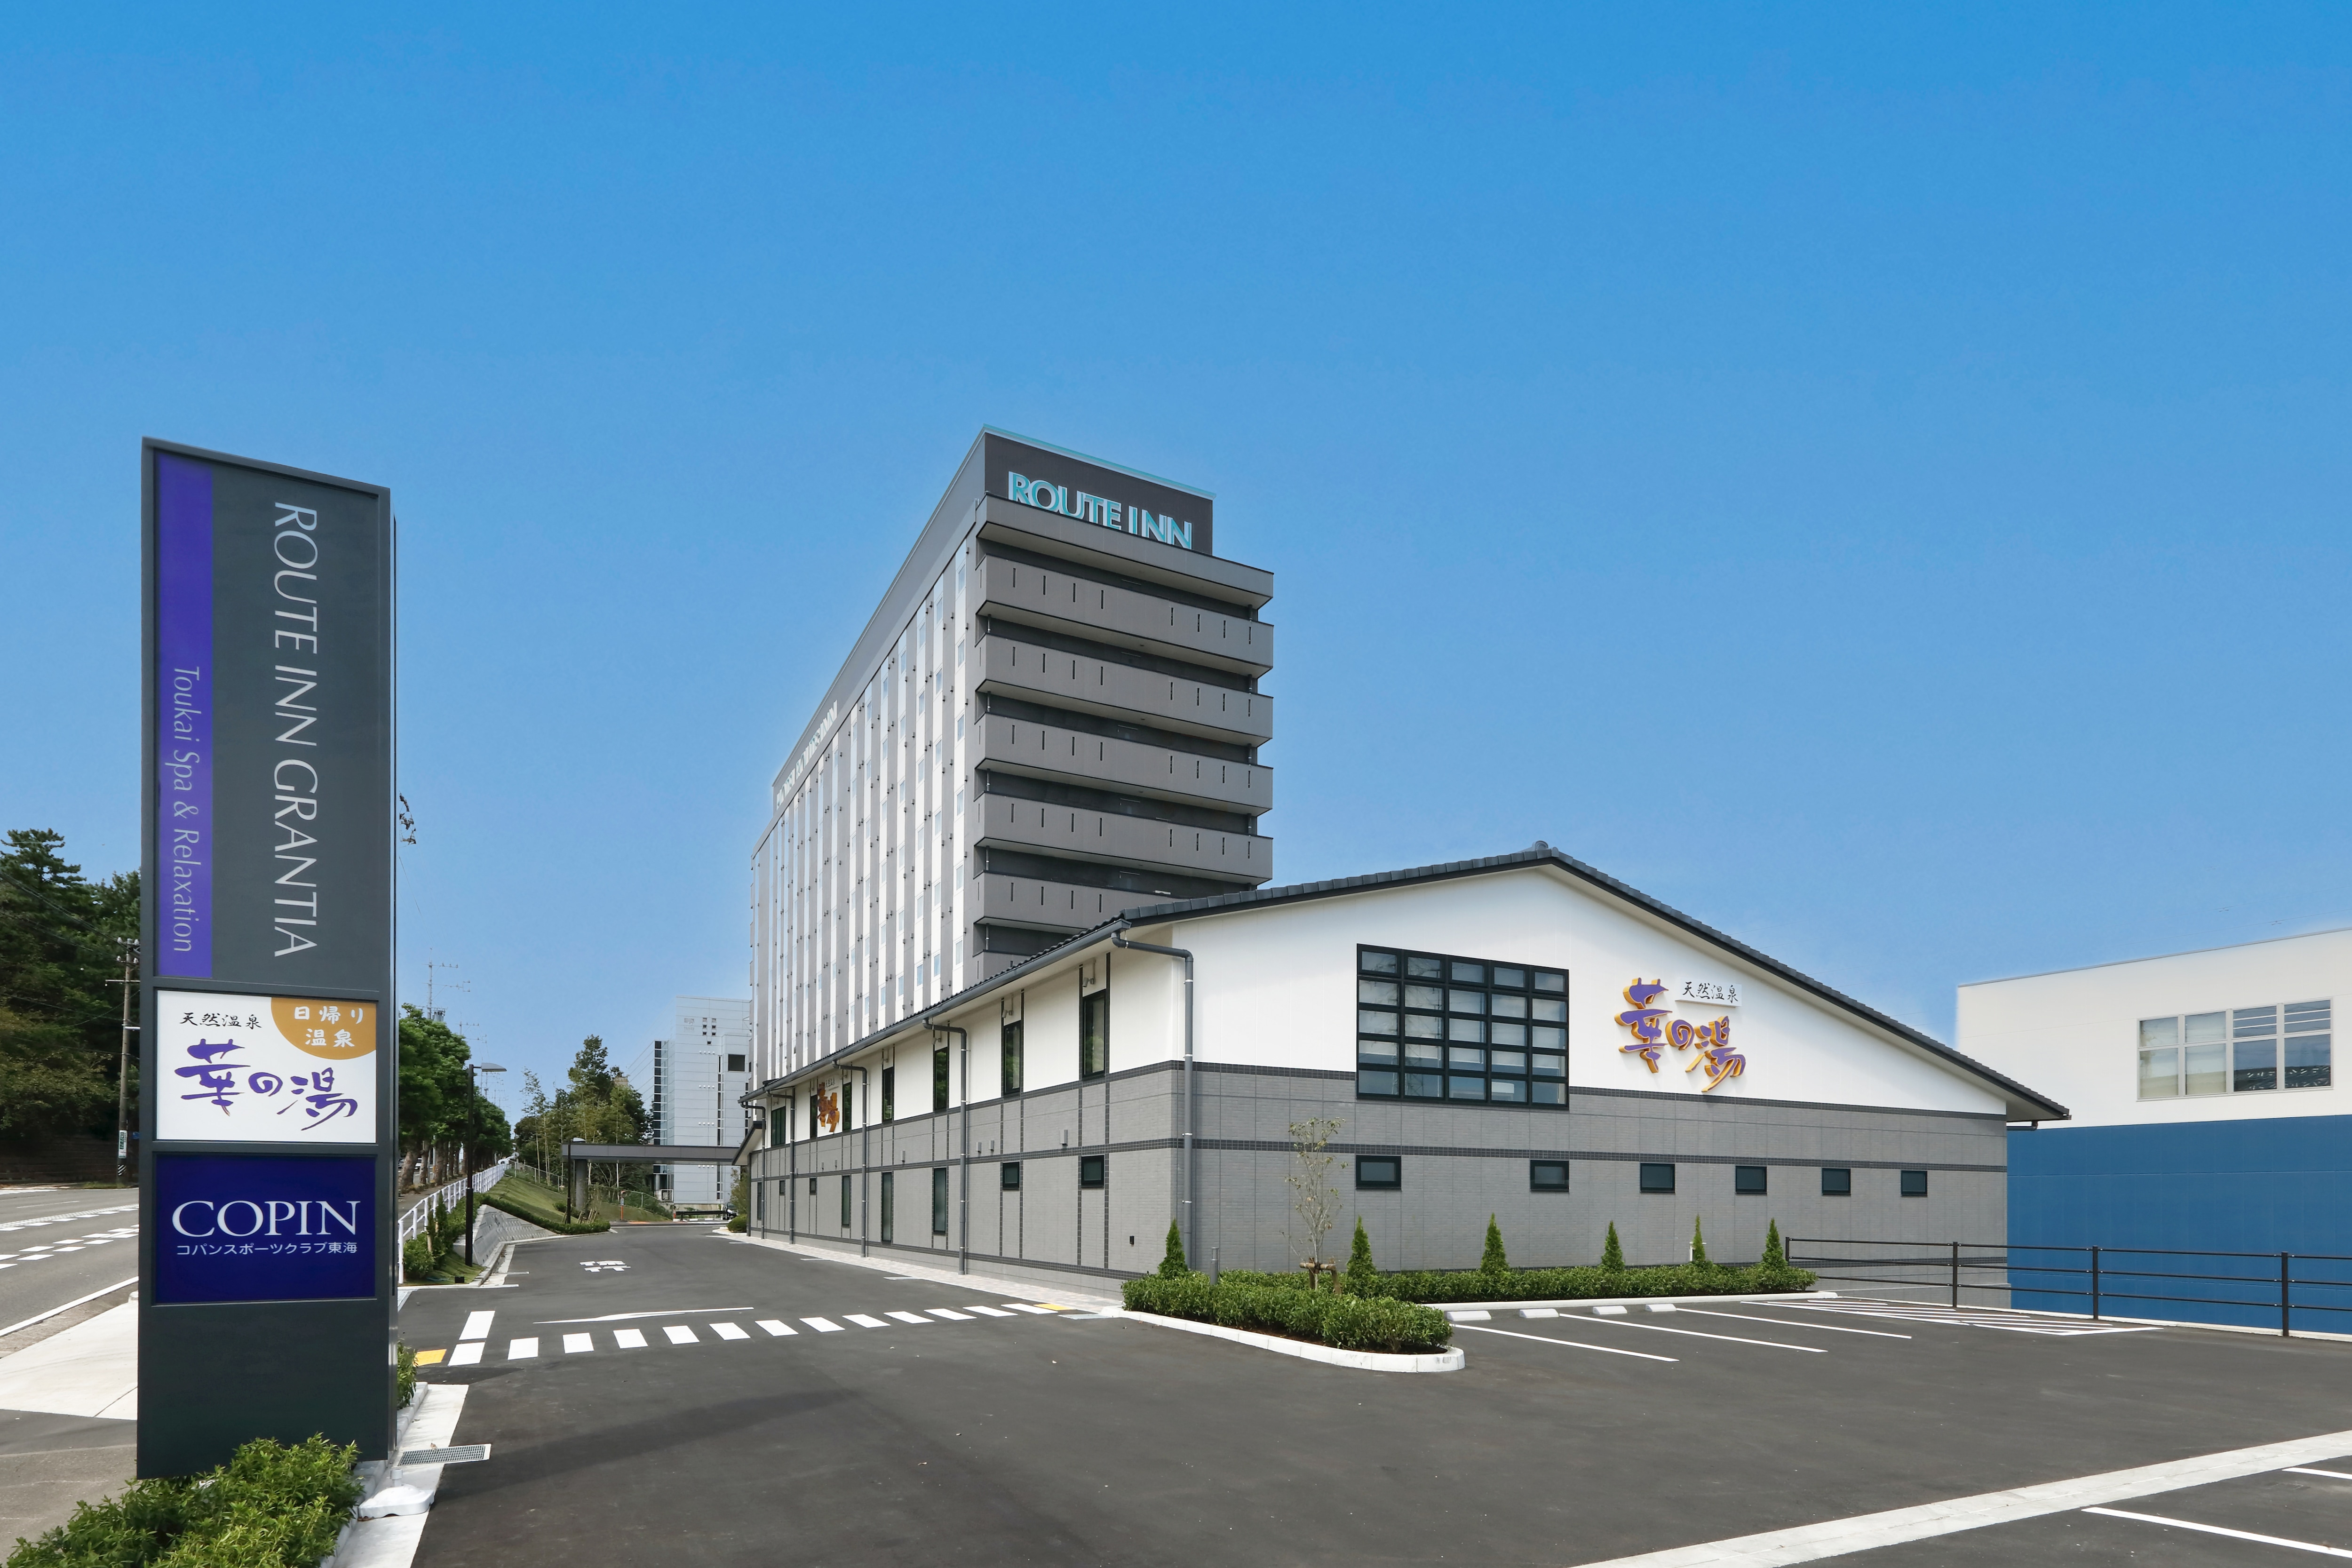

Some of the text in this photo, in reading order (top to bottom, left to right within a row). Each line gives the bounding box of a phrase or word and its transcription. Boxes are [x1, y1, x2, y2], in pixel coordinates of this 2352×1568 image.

[1009, 471, 1192, 550] ROUTE INN
[274, 501, 318, 957] ROUTE INN GRANTIA
[165, 666, 201, 952] Toukai Spa & Relaxation
[1682, 981, 1739, 1003] 天然温泉
[179, 1012, 262, 1030] 天然温泉
[294, 1006, 364, 1025] 日帰り
[305, 1028, 355, 1048] 温泉
[1614, 977, 1746, 1092] 華の湯
[174, 1038, 358, 1131] 華の湯
[172, 1201, 361, 1237] COPIN
[177, 1242, 358, 1256] コパンスポーツクラブ東海
